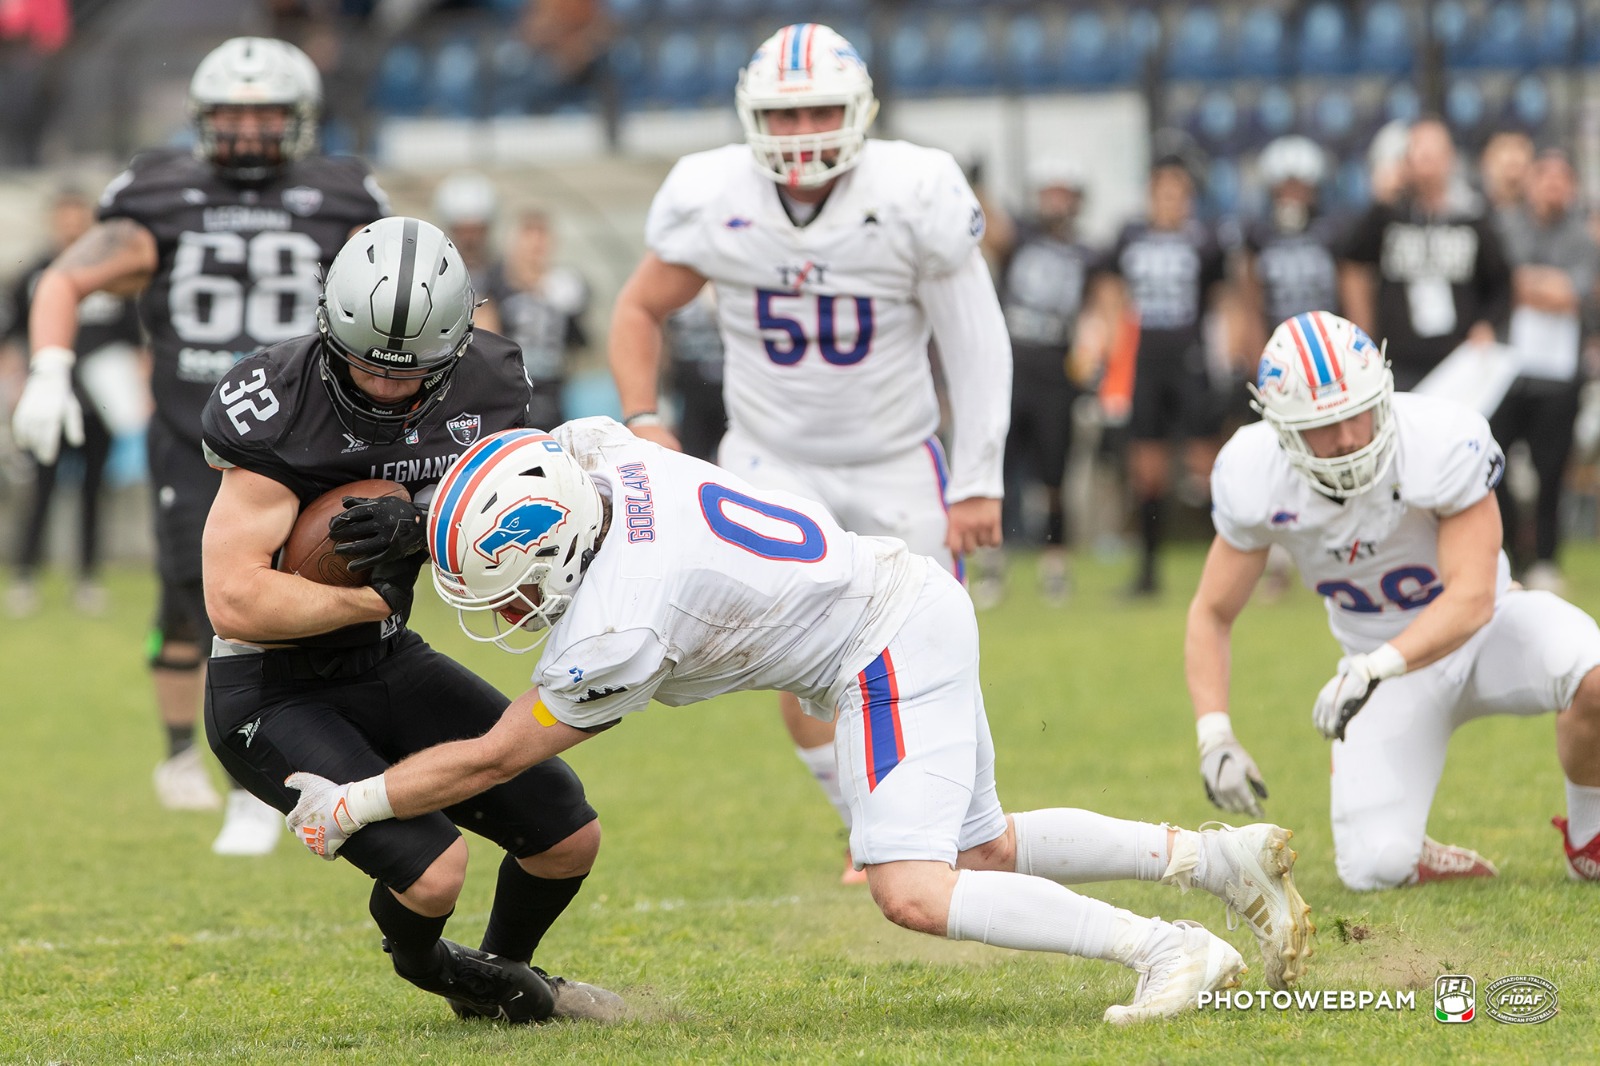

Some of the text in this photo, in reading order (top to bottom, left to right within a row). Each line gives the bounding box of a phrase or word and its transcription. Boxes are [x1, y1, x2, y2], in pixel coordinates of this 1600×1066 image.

[168, 230, 322, 344] 68
[371, 349, 413, 363] Riddell
[756, 288, 875, 367] 50
[219, 368, 280, 436] 32
[371, 407, 393, 415] Riddell
[449, 418, 478, 429] FROGS
[616, 461, 655, 544] GORLAMI
[698, 482, 827, 564] 0
